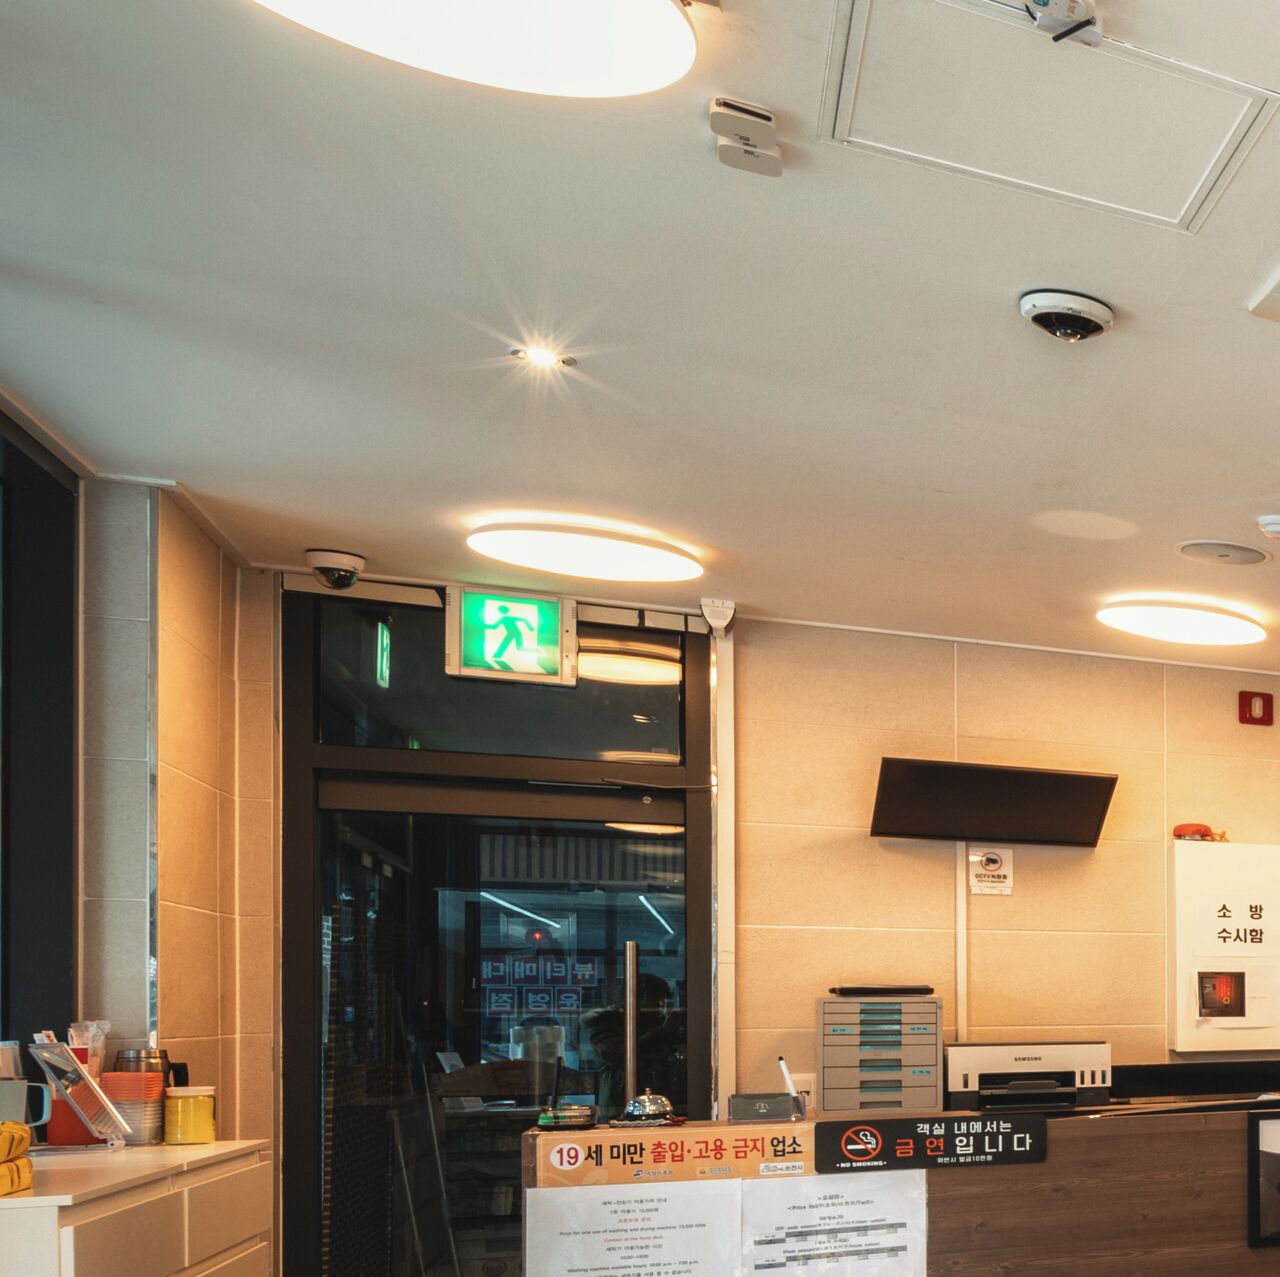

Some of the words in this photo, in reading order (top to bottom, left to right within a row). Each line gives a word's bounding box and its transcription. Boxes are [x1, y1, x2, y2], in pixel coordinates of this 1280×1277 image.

[1217, 928, 1264, 943] 수시함
[917, 1122, 945, 1135] 객실
[954, 1120, 1012, 1135] 내에서는
[609, 1142, 645, 1166] 미만
[732, 1136, 765, 1160] 금지
[770, 1135, 803, 1157] 업소
[852, 1160, 883, 1168] SMOKING
